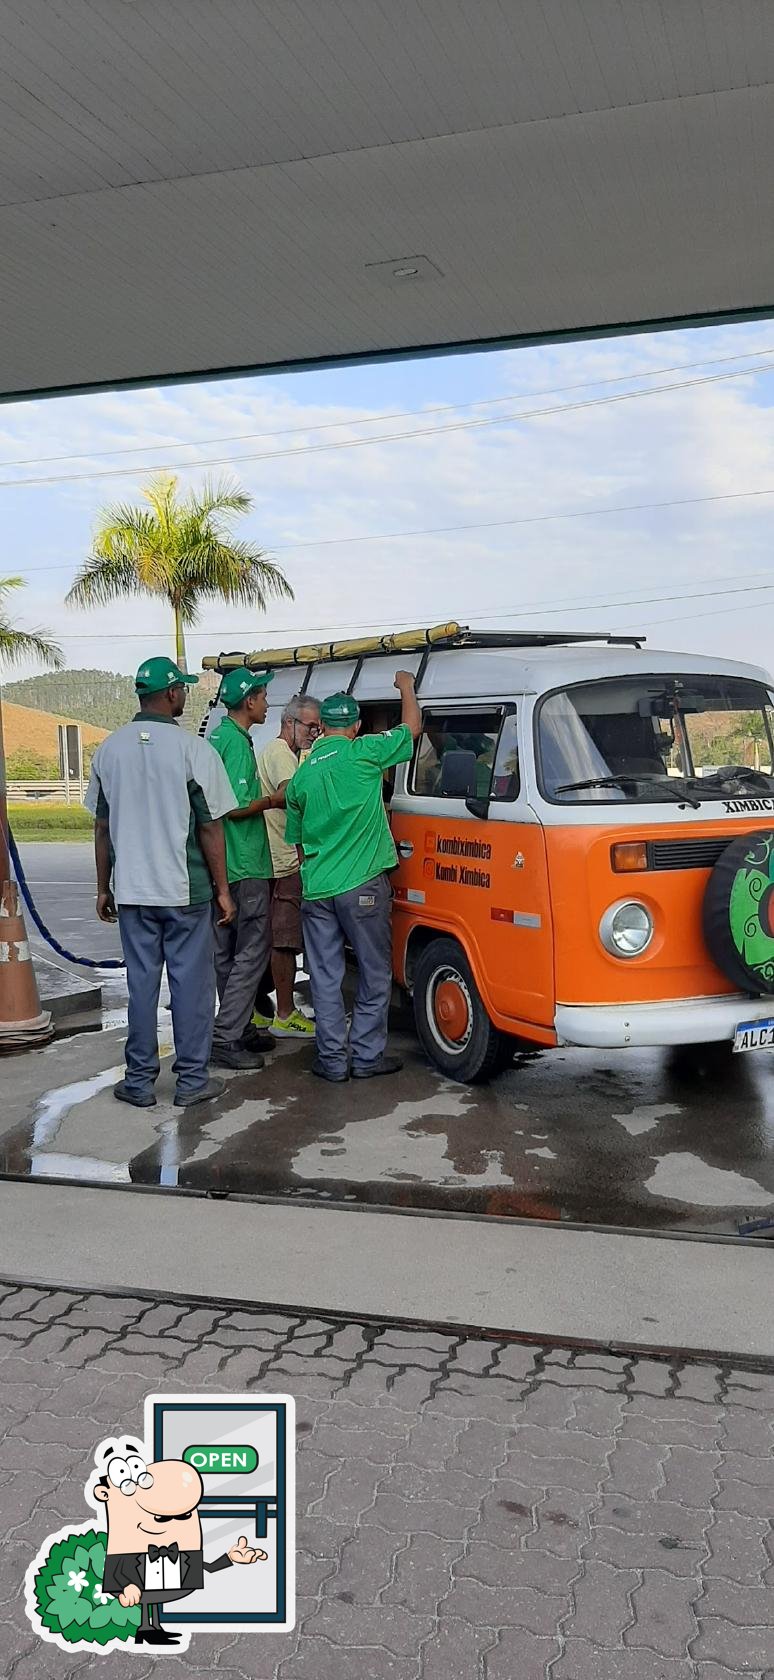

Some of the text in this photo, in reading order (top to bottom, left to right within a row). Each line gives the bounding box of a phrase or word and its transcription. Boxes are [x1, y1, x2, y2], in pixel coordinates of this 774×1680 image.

[721, 799, 774, 813] XIMBIC
[436, 862, 491, 889] Kombi Ximbica
